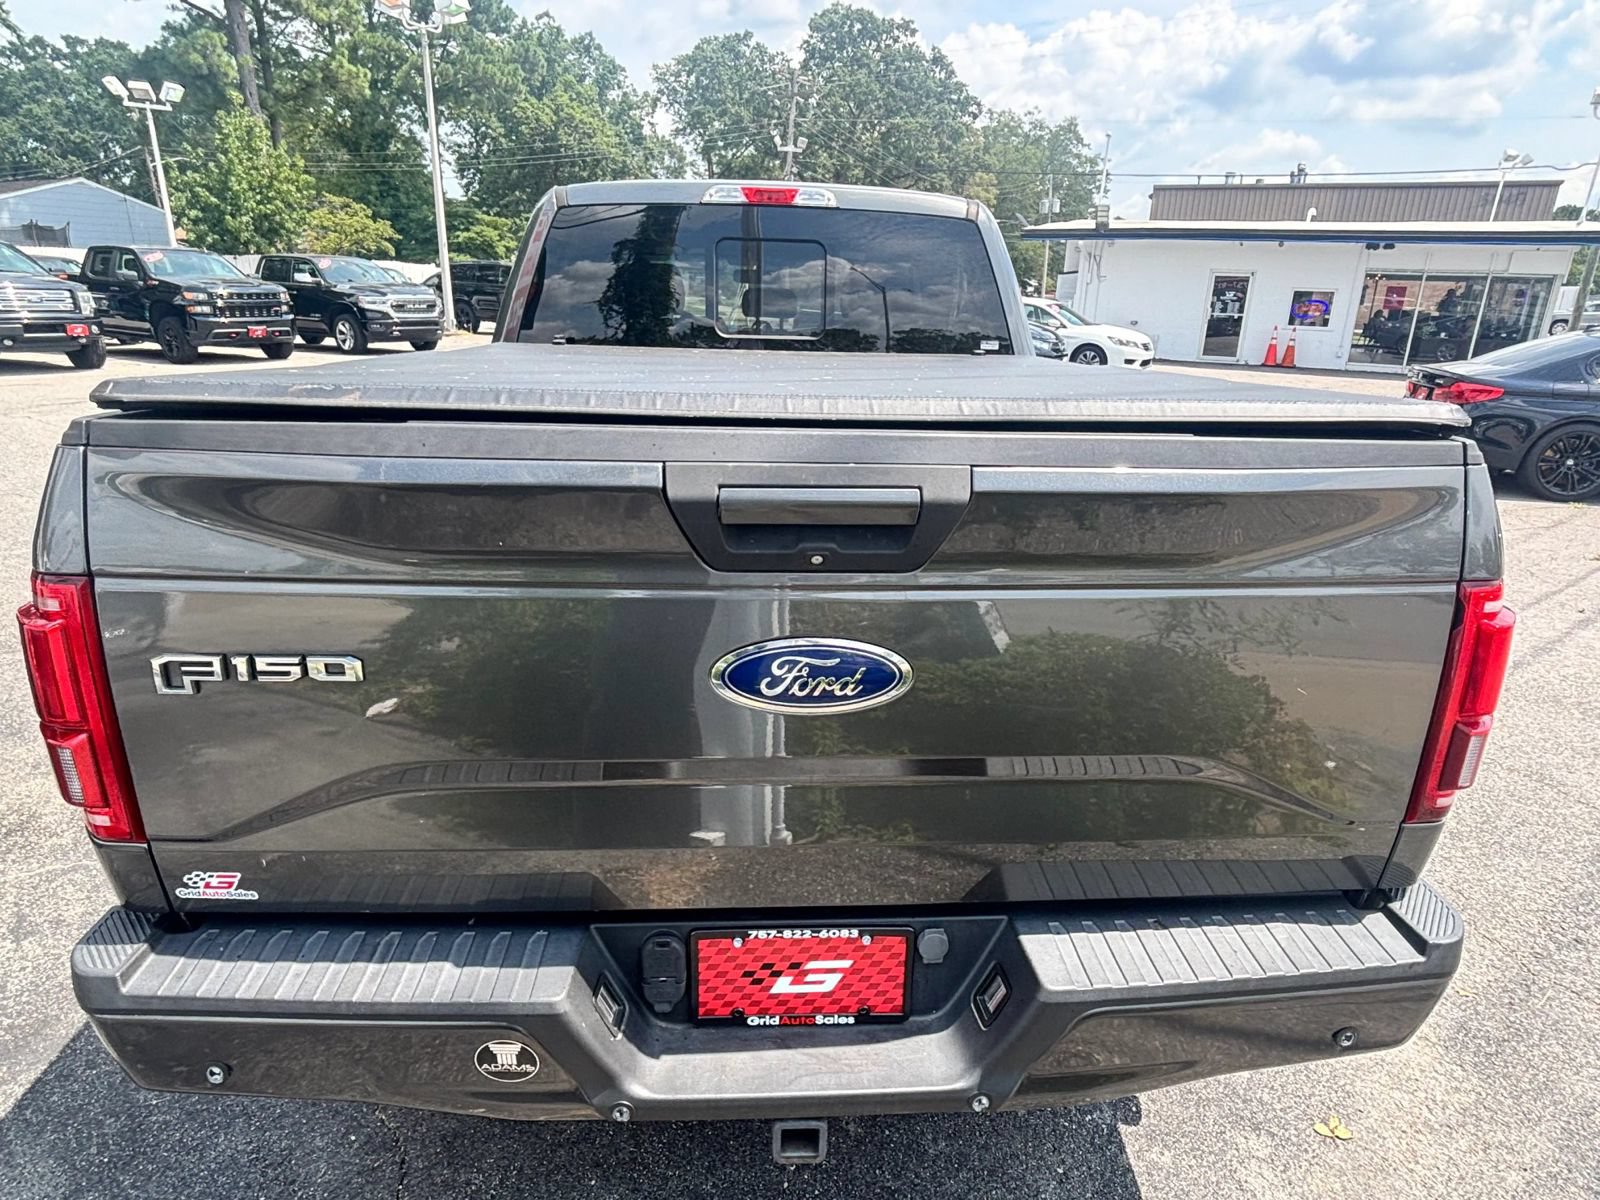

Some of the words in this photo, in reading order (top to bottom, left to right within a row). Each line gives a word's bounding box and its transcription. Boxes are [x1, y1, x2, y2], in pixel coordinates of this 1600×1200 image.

[760, 655, 867, 697] Ford
[178, 889, 257, 898] GridAutoSales
[747, 929, 860, 940] 757-822-6083
[746, 1014, 856, 1026] GridAutoSales
[480, 1063, 536, 1073] ADAMS
